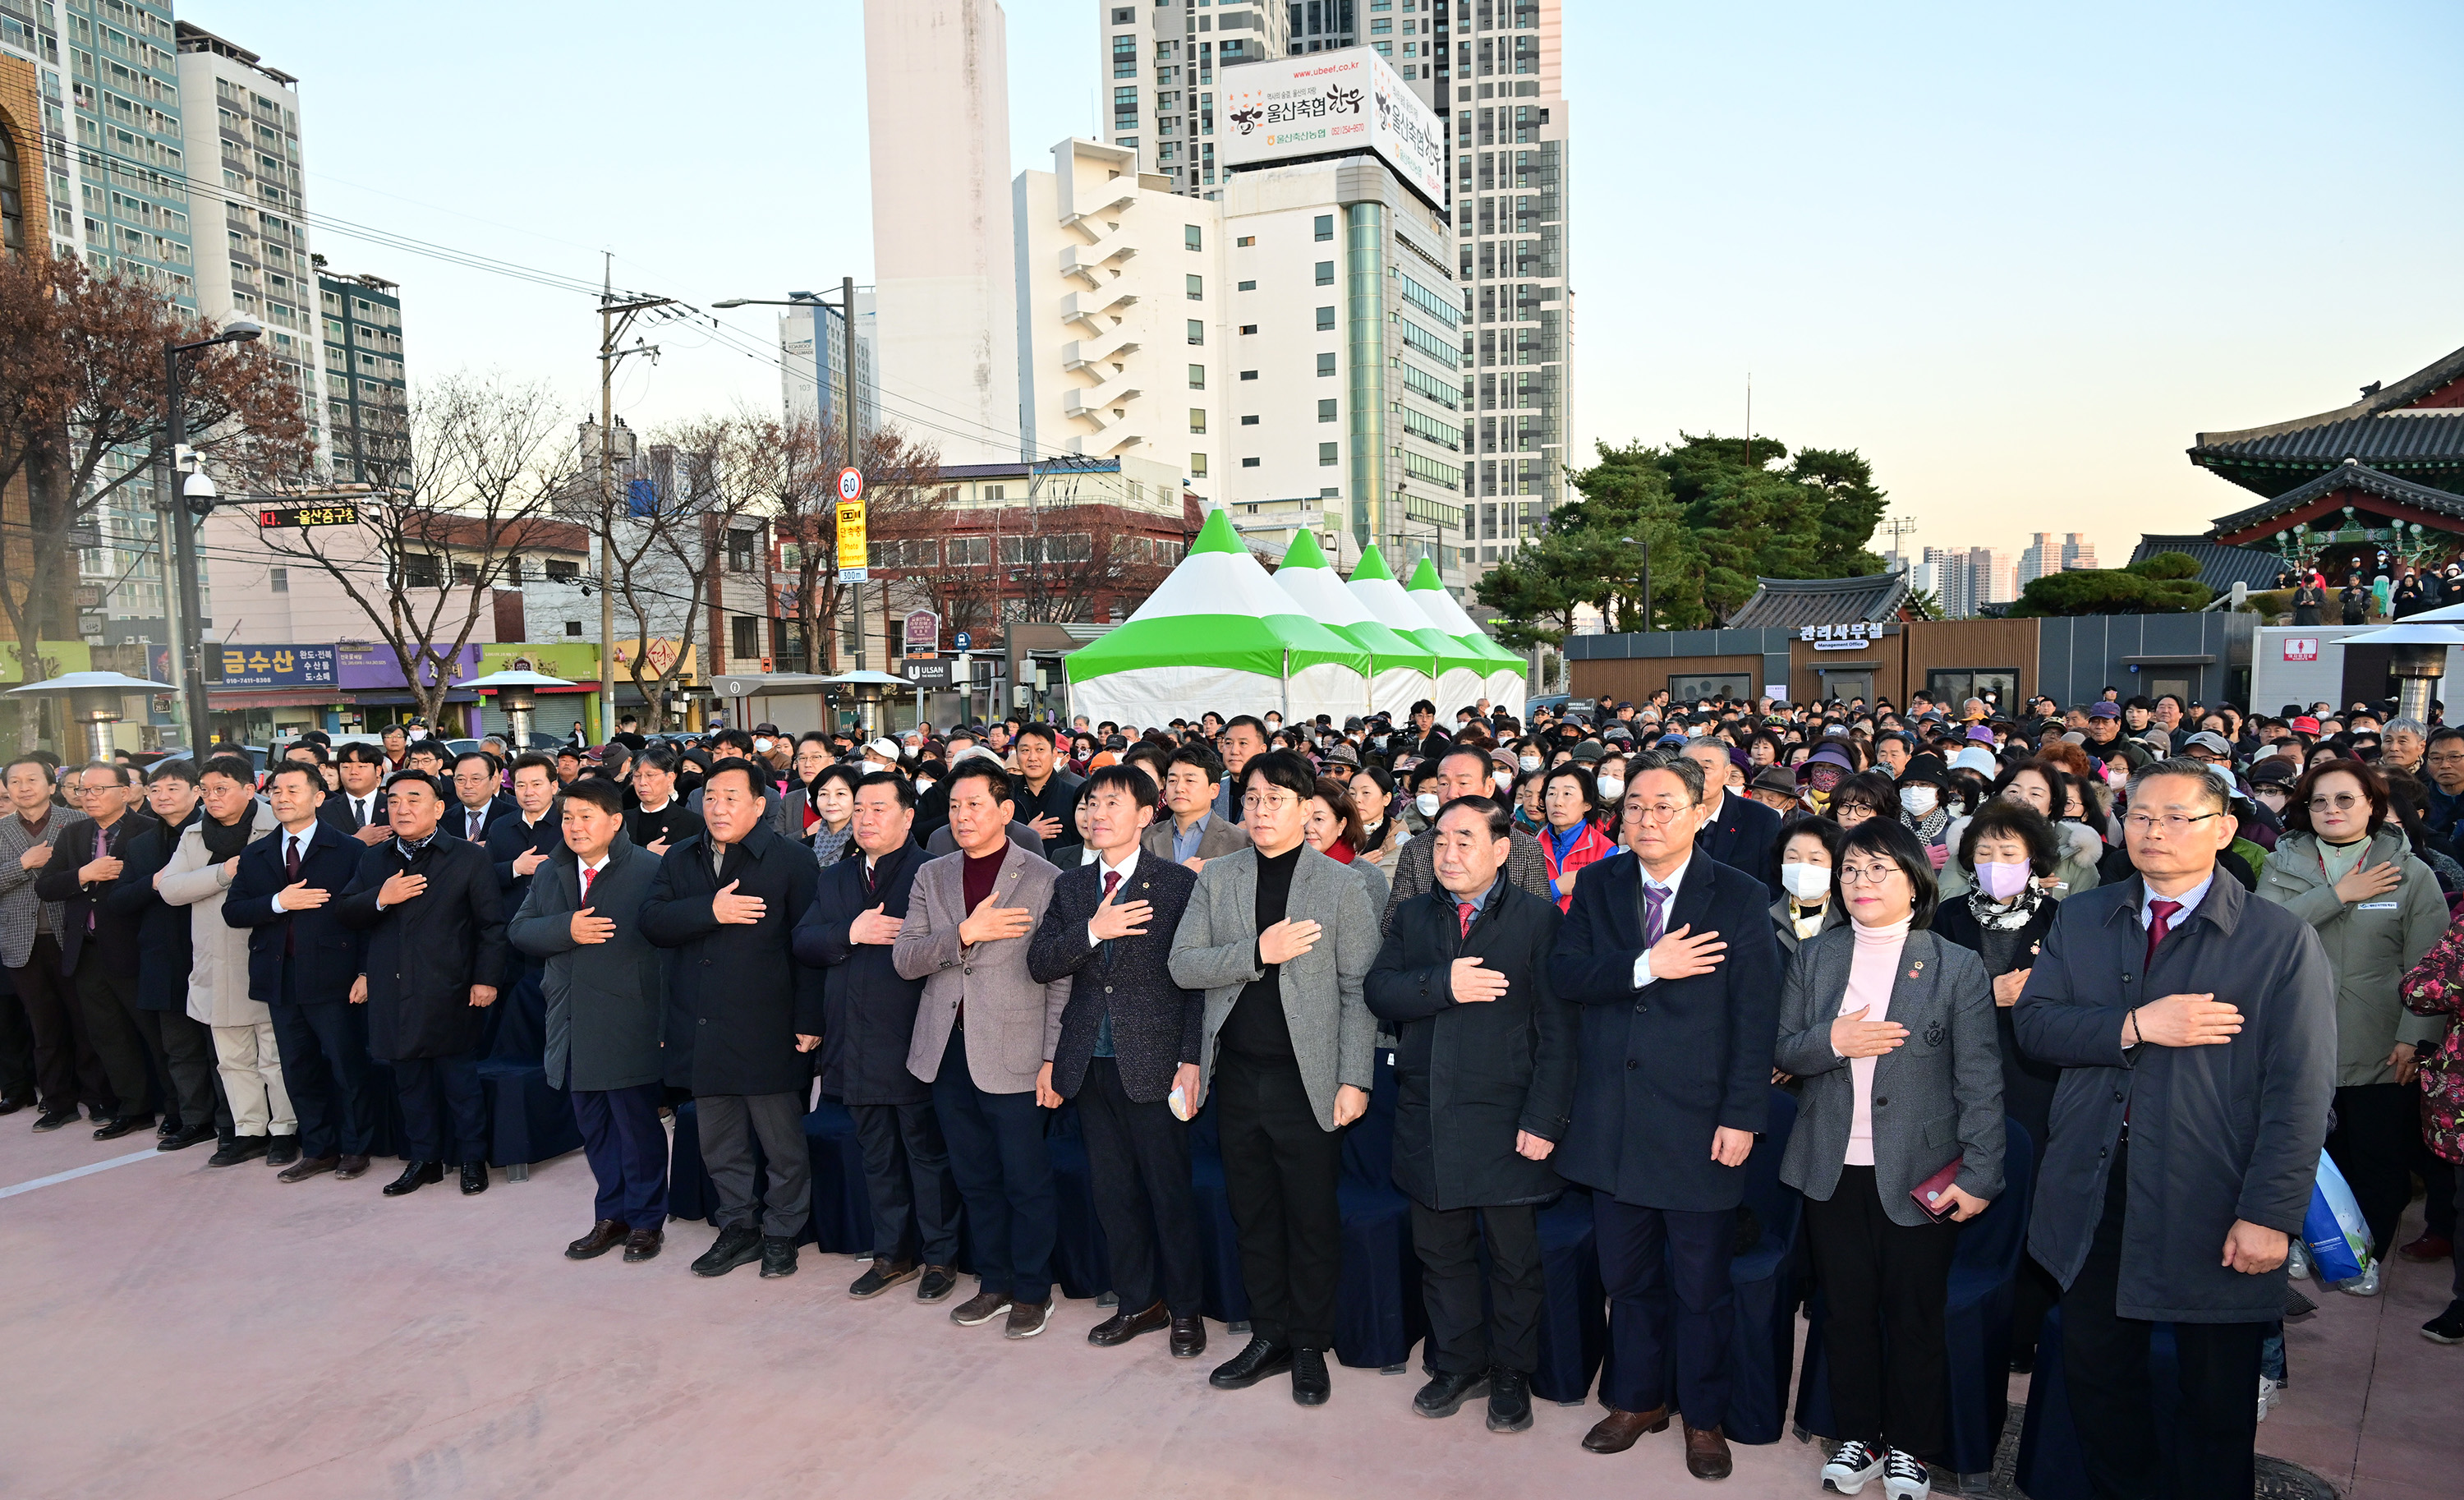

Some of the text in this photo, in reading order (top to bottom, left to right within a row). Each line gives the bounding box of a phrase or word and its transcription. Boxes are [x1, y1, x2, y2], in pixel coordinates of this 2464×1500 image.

[1293, 61, 1359, 79] www.ubeef.co.kr
[1266, 97, 1326, 124] 울산축협
[1326, 83, 1364, 114] 한우
[1276, 128, 1326, 145] 울산축산농협
[1392, 104, 1424, 158] 울산축협
[1542, 184, 1554, 192] 103
[798, 384, 811, 392] 103
[844, 477, 856, 493] 60
[260, 511, 281, 527] 다.
[839, 526, 862, 538] 단속중
[844, 571, 862, 580] 300m
[1800, 622, 1883, 642] 관리사무실
[223, 650, 295, 674] 금수산
